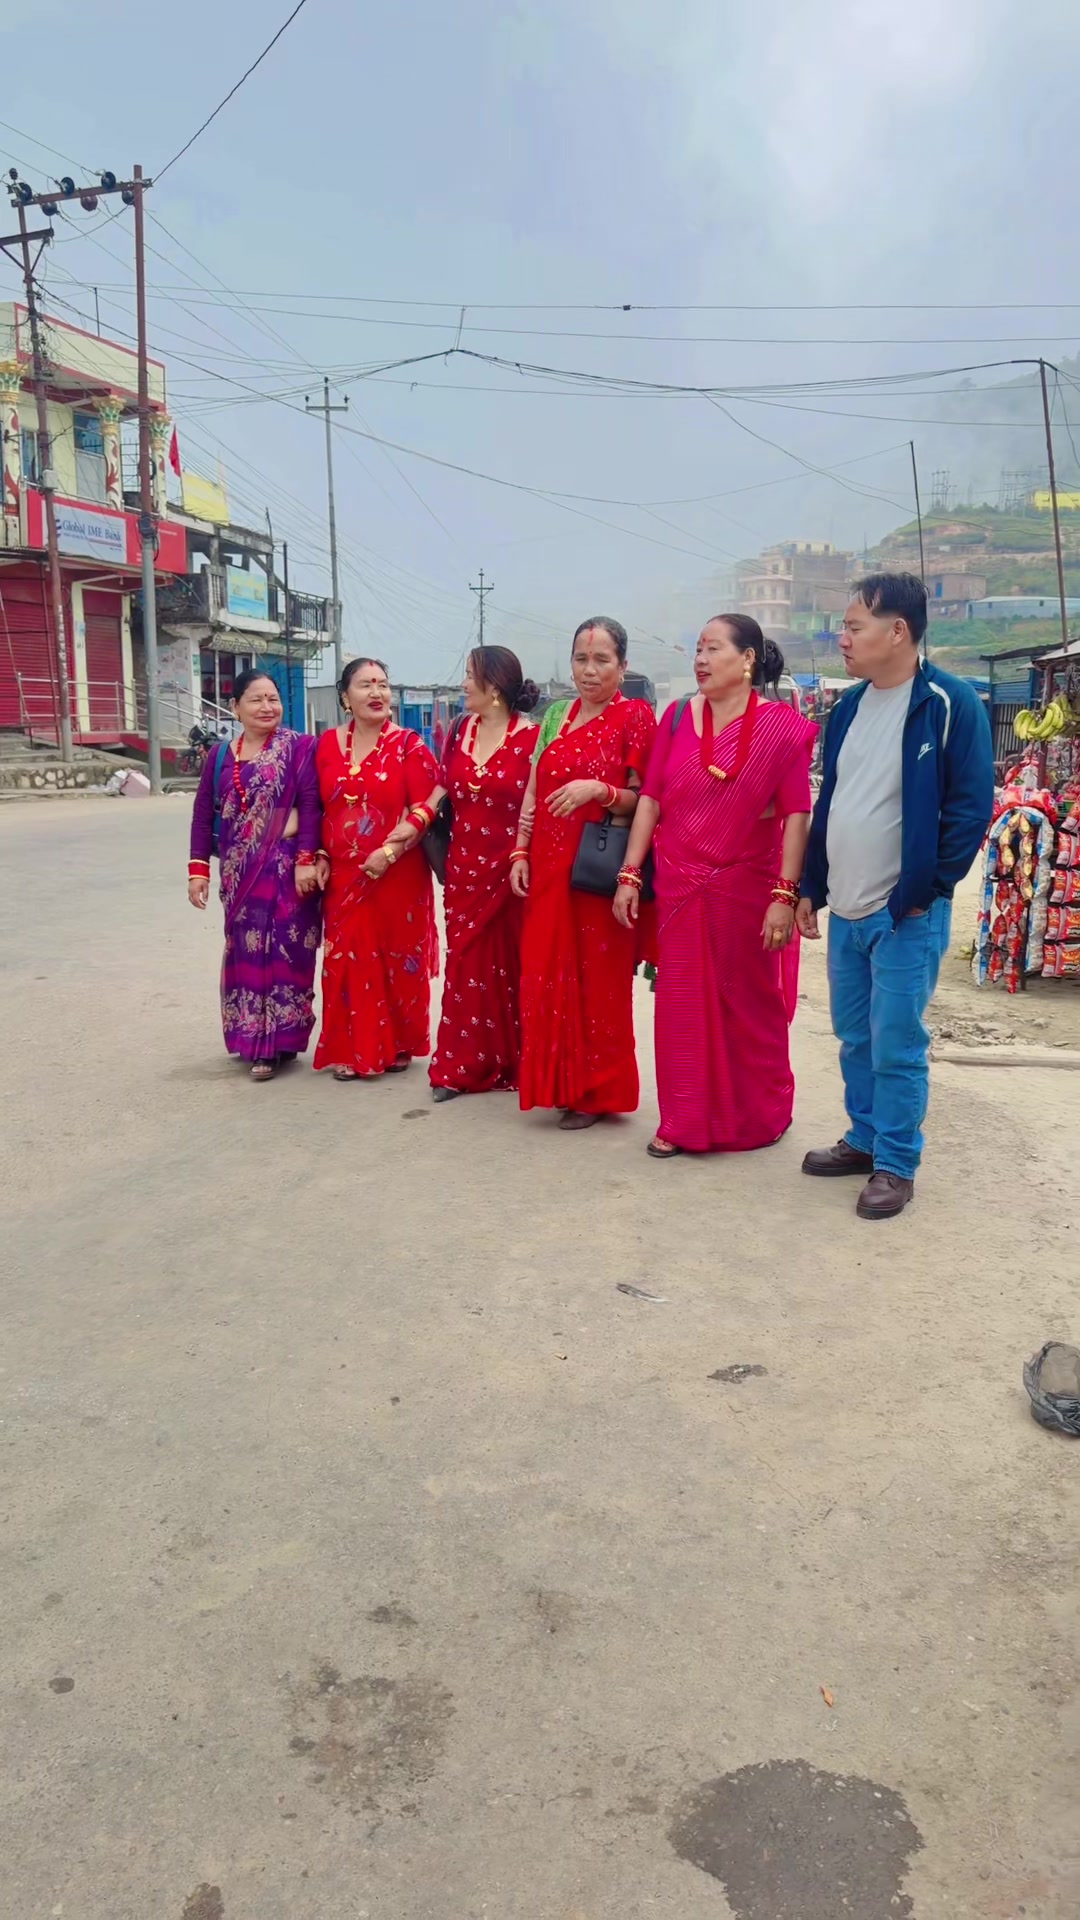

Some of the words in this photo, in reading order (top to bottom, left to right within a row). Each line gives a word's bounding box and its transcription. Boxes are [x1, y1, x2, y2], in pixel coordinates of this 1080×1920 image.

[63, 520, 85, 534] Global
[88, 525, 102, 537] IME
[105, 529, 121, 541] Bank
